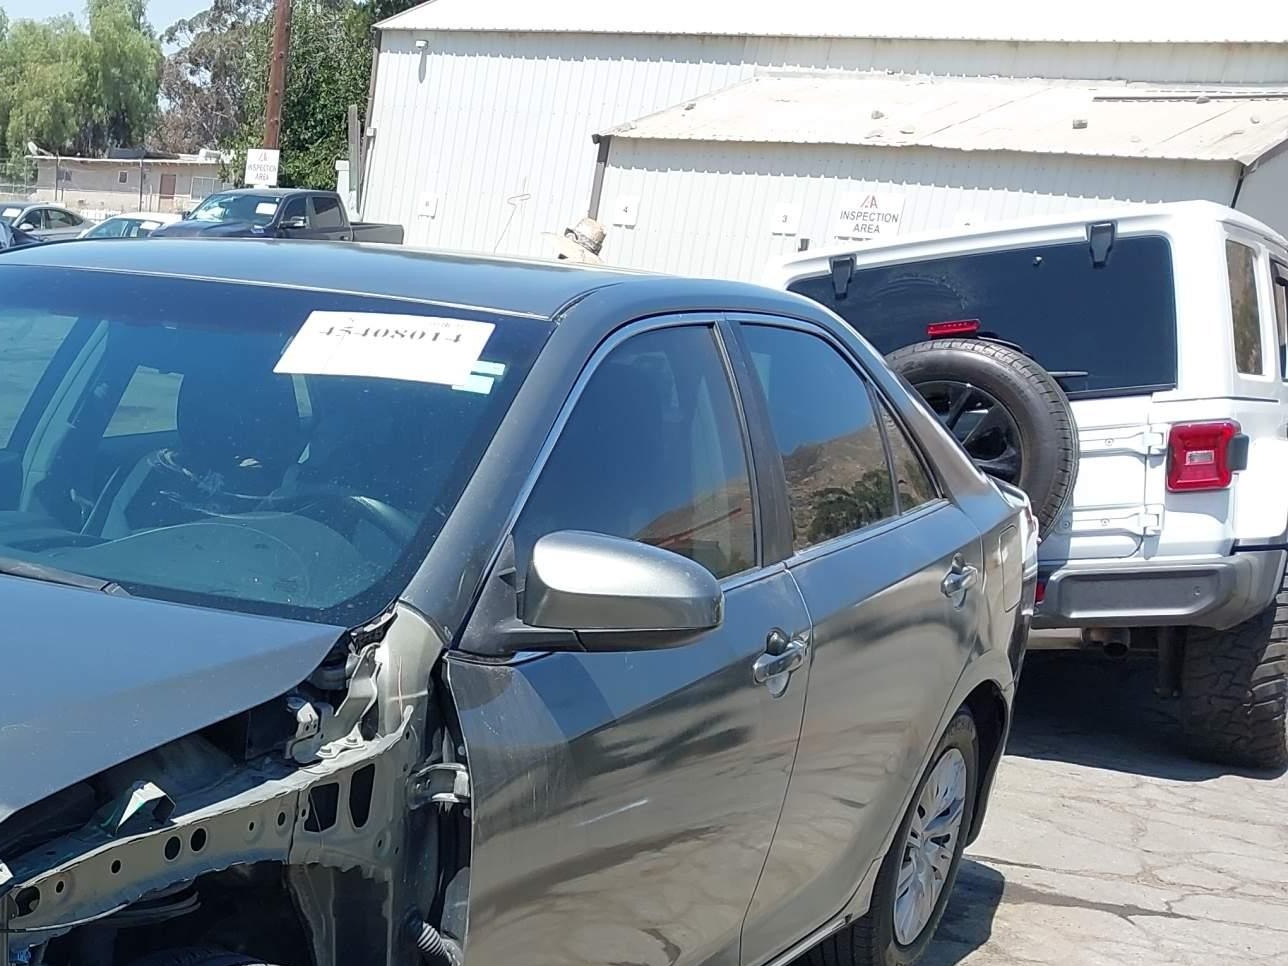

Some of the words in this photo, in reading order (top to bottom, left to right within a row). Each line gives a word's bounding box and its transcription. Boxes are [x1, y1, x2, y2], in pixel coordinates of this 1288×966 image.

[255, 173, 269, 181] AREA
[621, 205, 629, 214] 4
[781, 214, 788, 223] 3
[840, 210, 899, 223] INSPECTION
[853, 223, 880, 234] AREA
[319, 325, 462, 343] 45408014
